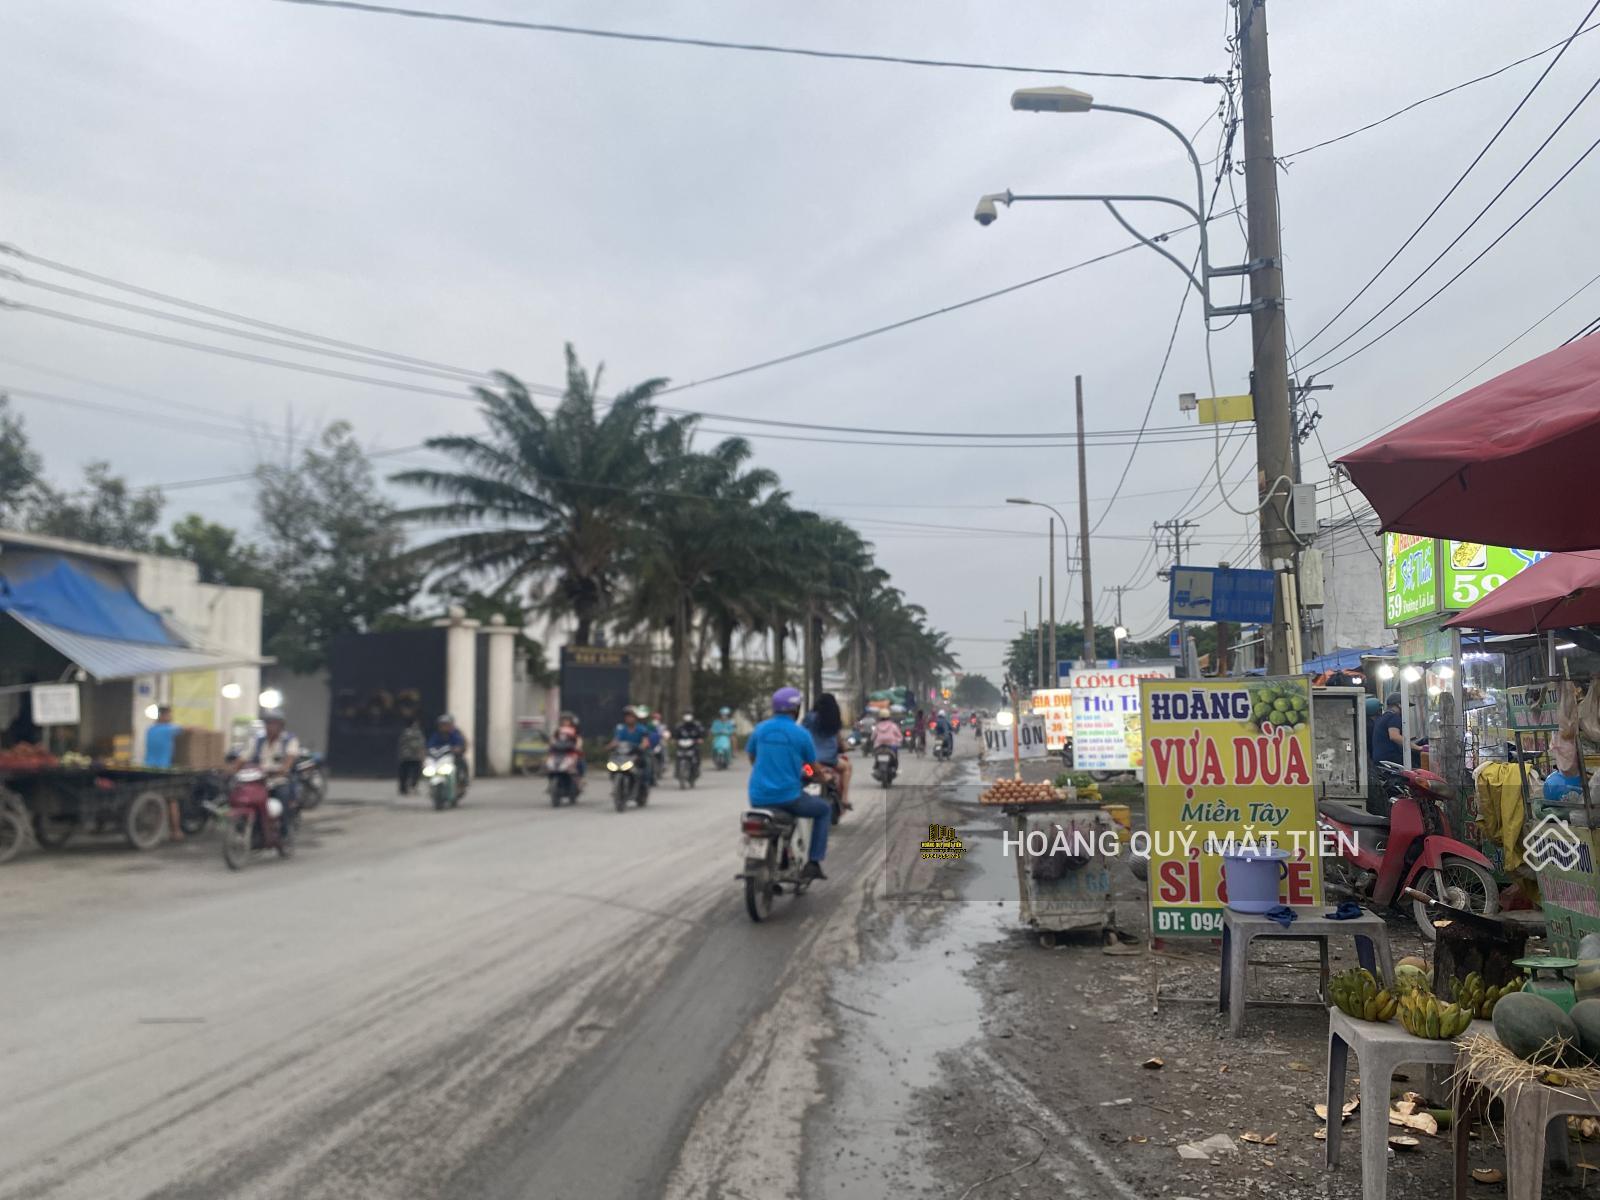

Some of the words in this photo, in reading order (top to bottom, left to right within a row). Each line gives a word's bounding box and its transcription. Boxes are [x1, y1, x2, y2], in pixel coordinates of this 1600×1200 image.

[1388, 593, 1402, 620] 59
[1075, 672, 1115, 688] CƠM
[1118, 694, 1141, 712] Ti
[1151, 688, 1250, 721] HOÀNG
[984, 729, 1008, 751] VỊT
[1017, 722, 1044, 751] ỘN
[1150, 728, 1226, 799] VỰA
[1234, 721, 1310, 786] DỪA
[1181, 799, 1241, 823] Miền
[1249, 803, 1290, 826] Tây
[1160, 847, 1201, 904] SỈ
[1279, 847, 1314, 905] Ẻ
[1158, 912, 1186, 930] ĐT:
